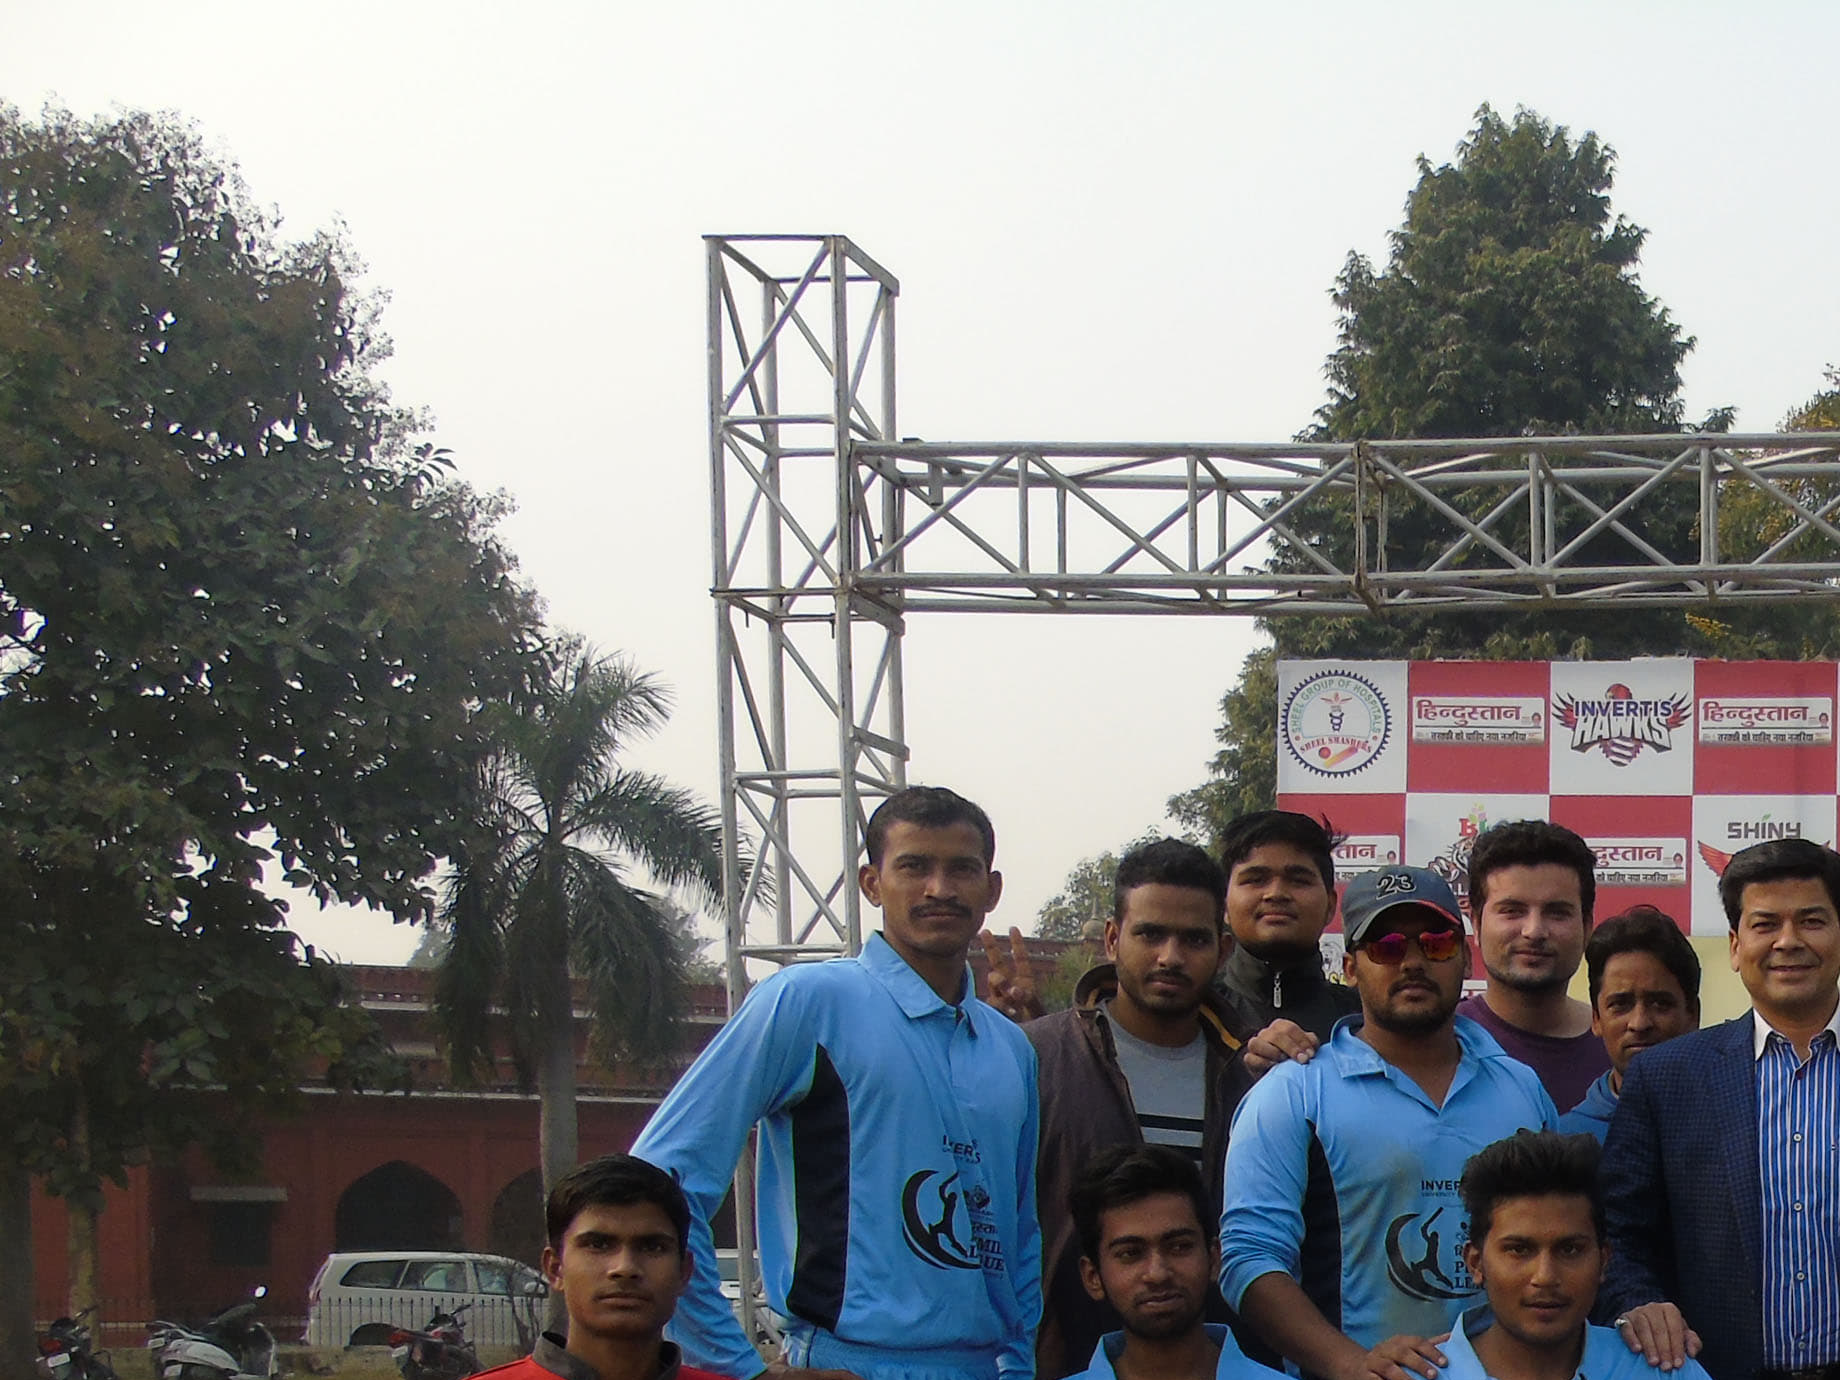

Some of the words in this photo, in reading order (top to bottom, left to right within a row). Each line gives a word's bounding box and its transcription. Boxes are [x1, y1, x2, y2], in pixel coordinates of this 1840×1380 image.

[1291, 703, 1304, 733] SHEEL
[1301, 679, 1334, 701] GROUP
[1338, 679, 1351, 689] OF
[1353, 684, 1382, 734] HOSPITALS
[1417, 699, 1522, 728] हिन्दुस्तान
[1575, 700, 1672, 717] INVERTIS
[1703, 701, 1809, 728] हिन्दुस्तान
[1300, 737, 1325, 754] SHEEL
[1328, 736, 1372, 753] SMASHERS
[1571, 716, 1672, 750] HAWKS
[1727, 822, 1801, 839] SHINY
